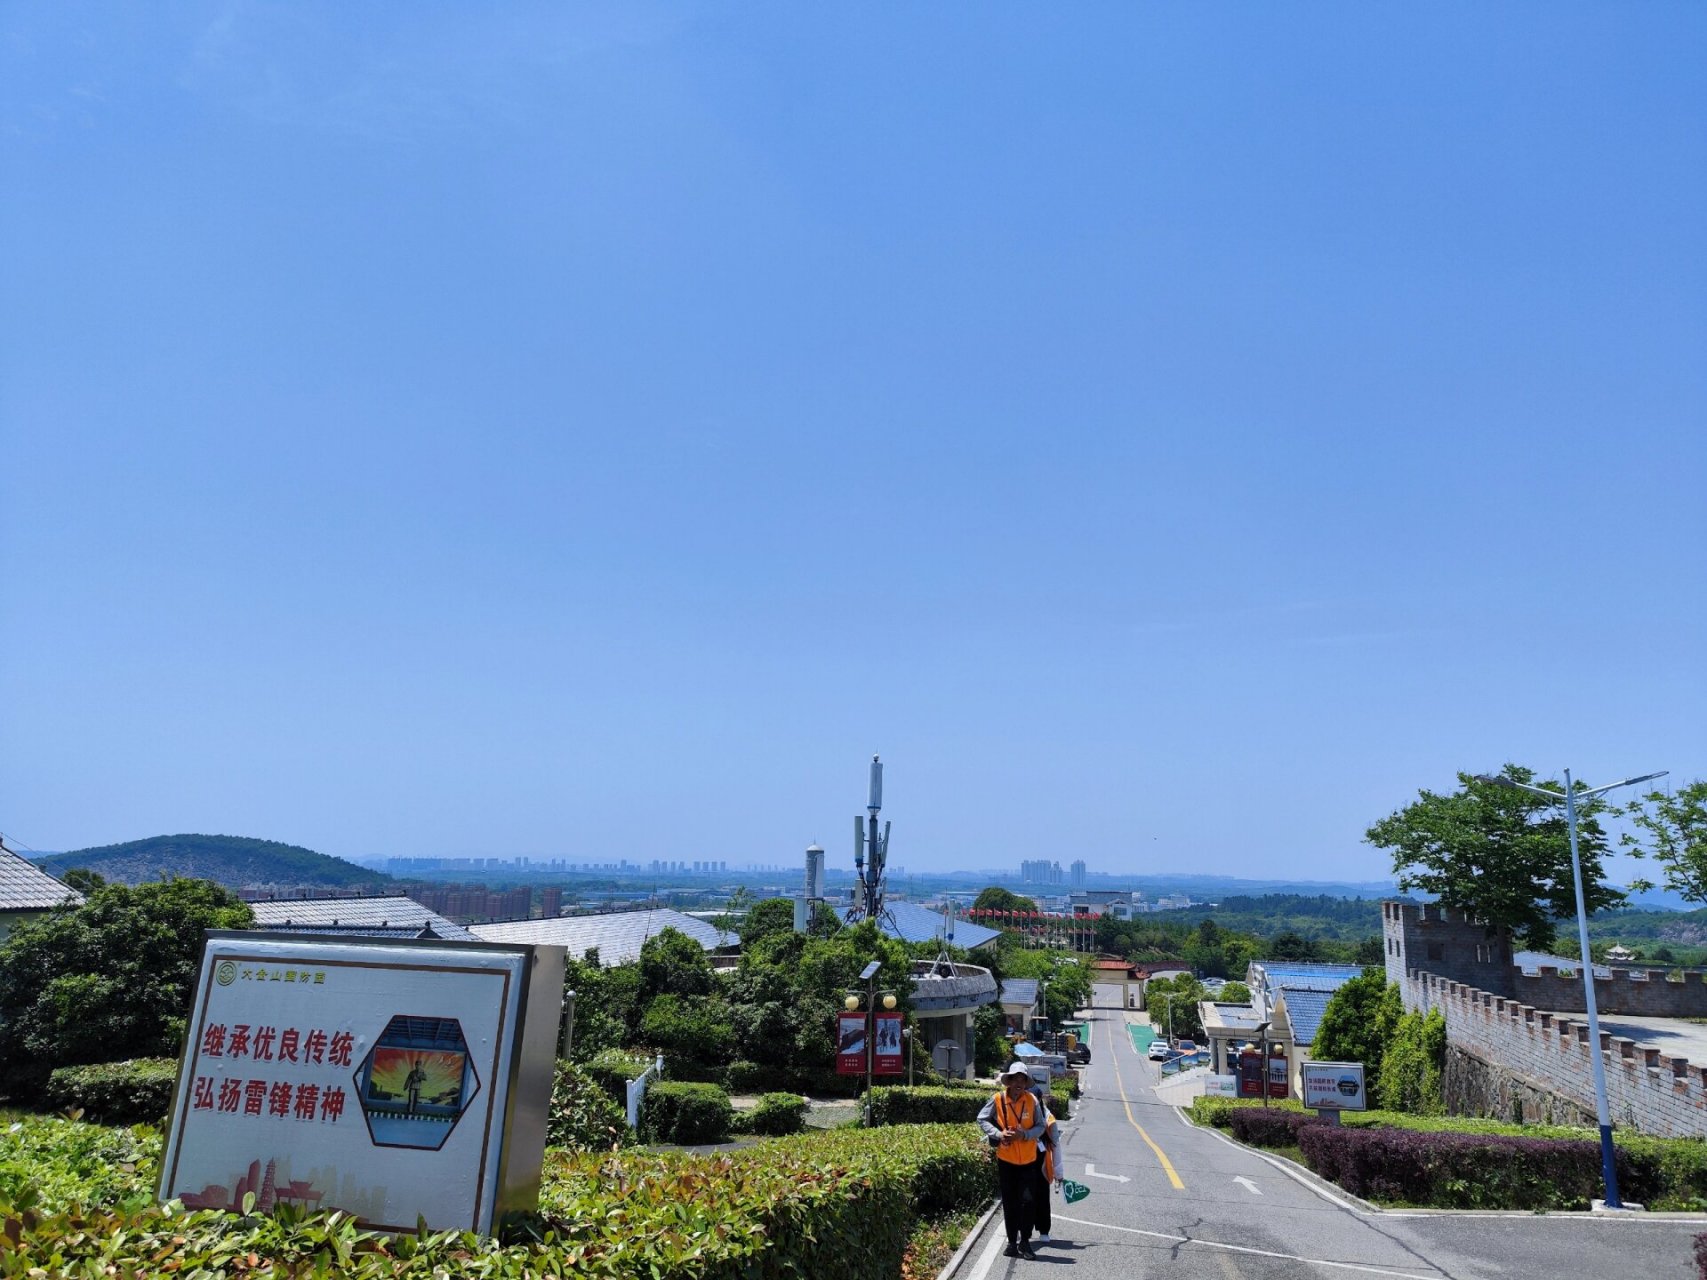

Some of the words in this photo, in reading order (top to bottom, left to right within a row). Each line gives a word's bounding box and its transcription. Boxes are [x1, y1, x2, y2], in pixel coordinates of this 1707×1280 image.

[201, 1022, 355, 1067] 继承优良传统
[193, 1076, 346, 1122] 弘扬雷锋精神
